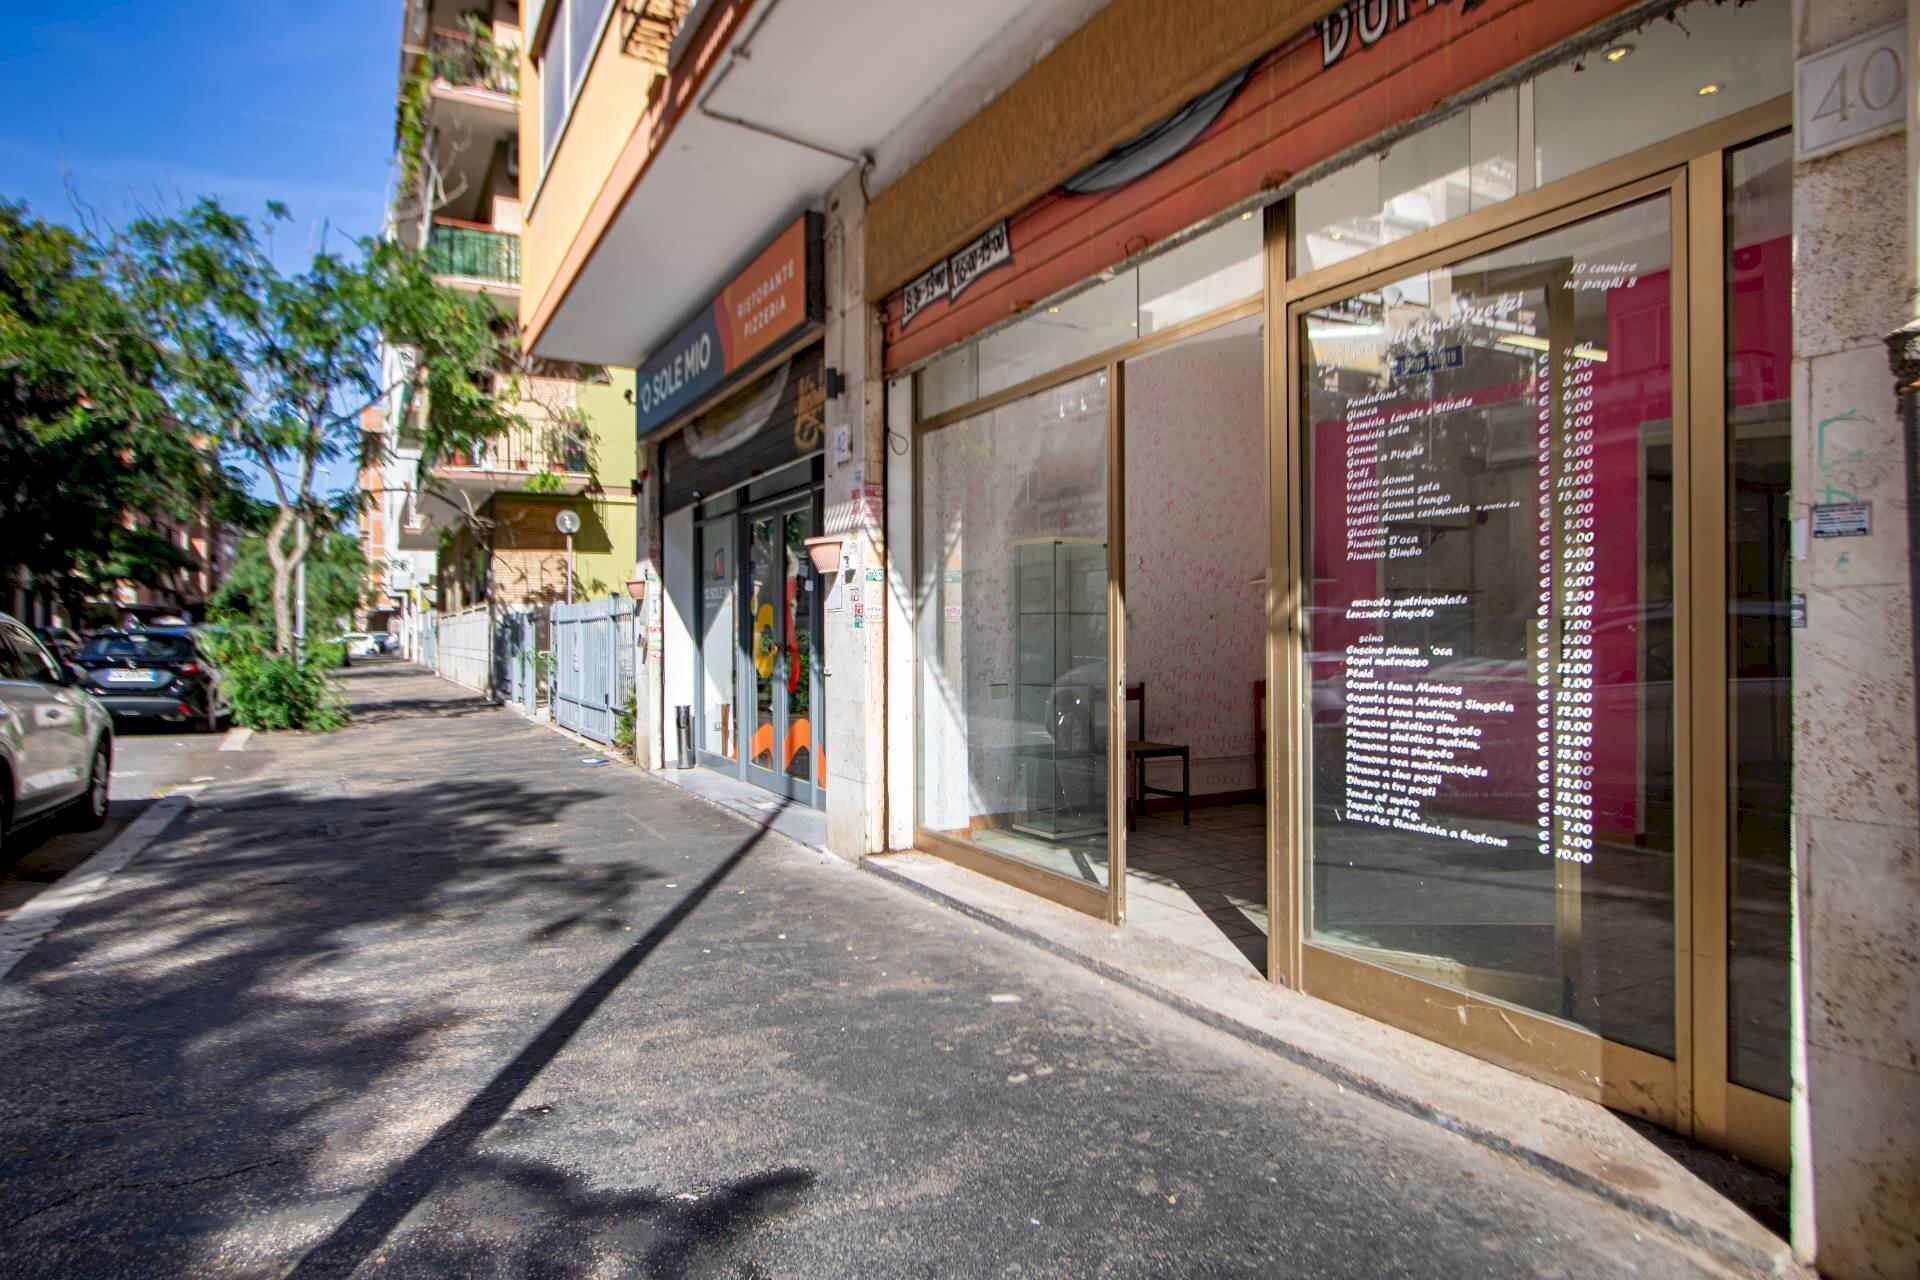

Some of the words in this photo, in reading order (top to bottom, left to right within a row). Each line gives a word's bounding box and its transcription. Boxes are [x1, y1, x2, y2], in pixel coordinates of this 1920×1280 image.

[1809, 47, 1902, 122] 40
[1570, 261, 1587, 274] 10
[736, 258, 795, 318] RISTORANTE
[1581, 276, 1625, 292] paghi
[744, 294, 786, 338] PIZZERIA
[652, 353, 683, 406] SOLE
[684, 332, 711, 382] MIO
[1346, 390, 1398, 408] Pantalone
[1563, 385, 1593, 401] 6.00
[1346, 406, 1378, 422] Giacca
[1346, 417, 1385, 432] Camicia
[1391, 408, 1424, 424] Lavate
[1435, 397, 1473, 414] Stirate
[1563, 400, 1593, 416] 4.00
[1346, 429, 1385, 444] Camicia
[1388, 424, 1410, 437] seta
[1346, 443, 1378, 457] Gonna
[1563, 444, 1593, 458] 6.00
[1346, 456, 1378, 469] Gonna
[1380, 453, 1387, 462] a
[1390, 447, 1425, 460] Pieghe
[1346, 467, 1370, 480] Golf
[1564, 459, 1593, 473] 8.00
[1346, 479, 1379, 491] Vestito
[1382, 474, 1415, 486] donna
[1557, 473, 1593, 488] 10.00
[1346, 491, 1379, 503] Vestito
[1382, 486, 1414, 498] donna
[1417, 482, 1440, 491] seta
[1346, 503, 1379, 515] Vestito
[1382, 499, 1414, 509] donna
[1417, 494, 1451, 506] lungo
[1563, 502, 1593, 516] 6.00
[1346, 514, 1379, 527] Vestito
[1382, 511, 1414, 522] donna
[1417, 503, 1470, 518] cerimonia
[1564, 517, 1593, 530] 8.00
[1347, 526, 1389, 539] Giaccone
[1564, 532, 1594, 545] 4.00
[1347, 538, 1387, 550] Piumino
[1389, 534, 1419, 546] D'oca
[1347, 549, 1387, 561] Piumino
[1389, 546, 1422, 559] Bimbo
[1563, 546, 1595, 559] 6.00
[1563, 560, 1595, 573] 7.00
[1563, 575, 1595, 588] 6.00
[1393, 594, 1468, 607] matrimoniale
[1346, 608, 1390, 619] Lenzuolo
[1392, 607, 1435, 620] singolo
[1563, 604, 1593, 616] 2.00
[1563, 619, 1592, 630] 1.00
[1346, 645, 1384, 656] Cuscino
[1386, 645, 1420, 657] piuma
[1562, 648, 1593, 660] 7.00
[1346, 656, 1373, 667] Copri
[1374, 656, 1429, 668] materasso
[1557, 663, 1593, 674] 12.00
[1346, 668, 1374, 679] Plaid
[1346, 679, 1385, 691] Coperta
[1387, 681, 1413, 692] lana
[1415, 683, 1463, 695] Merinos
[1346, 692, 1385, 704] Coperta
[1387, 694, 1413, 706] lana
[1415, 697, 1463, 709] Merinos
[1465, 699, 1515, 713] Singola
[1346, 704, 1385, 717] Coperta
[1387, 706, 1413, 718] lana
[1415, 710, 1458, 722] matrim.
[1557, 706, 1593, 718] 12.00
[1346, 716, 1388, 728] Piumone
[1390, 720, 1434, 733] sintetico
[1436, 724, 1482, 737] singolo
[1346, 728, 1388, 740] Piumone
[1390, 732, 1434, 745] sintetico
[1436, 737, 1481, 750] matrim.
[1557, 734, 1593, 747] 12.00
[1346, 739, 1388, 752] Piumone
[1390, 744, 1409, 755] oca
[1410, 746, 1454, 760] singolo
[1346, 751, 1388, 765] Piumone
[1390, 757, 1409, 768] oca
[1410, 761, 1488, 778] matrimoniale
[1557, 763, 1594, 776] 14.00
[1346, 763, 1381, 776] Divano
[1382, 769, 1390, 778] a
[1391, 768, 1412, 781] due
[1413, 773, 1442, 785] posti
[1346, 775, 1381, 789] Divano
[1382, 782, 1390, 791] a
[1391, 781, 1406, 793] tre
[1408, 785, 1437, 797] posti
[1346, 788, 1373, 801] Tende
[1375, 793, 1388, 803] al
[1390, 796, 1420, 808] metro
[1346, 799, 1385, 814] Tappeto
[1386, 807, 1400, 816] al
[1553, 805, 1593, 820] 30.00
[1449, 830, 1458, 839] a
[1562, 820, 1593, 834] 7.00
[1556, 848, 1593, 864] 10.00
